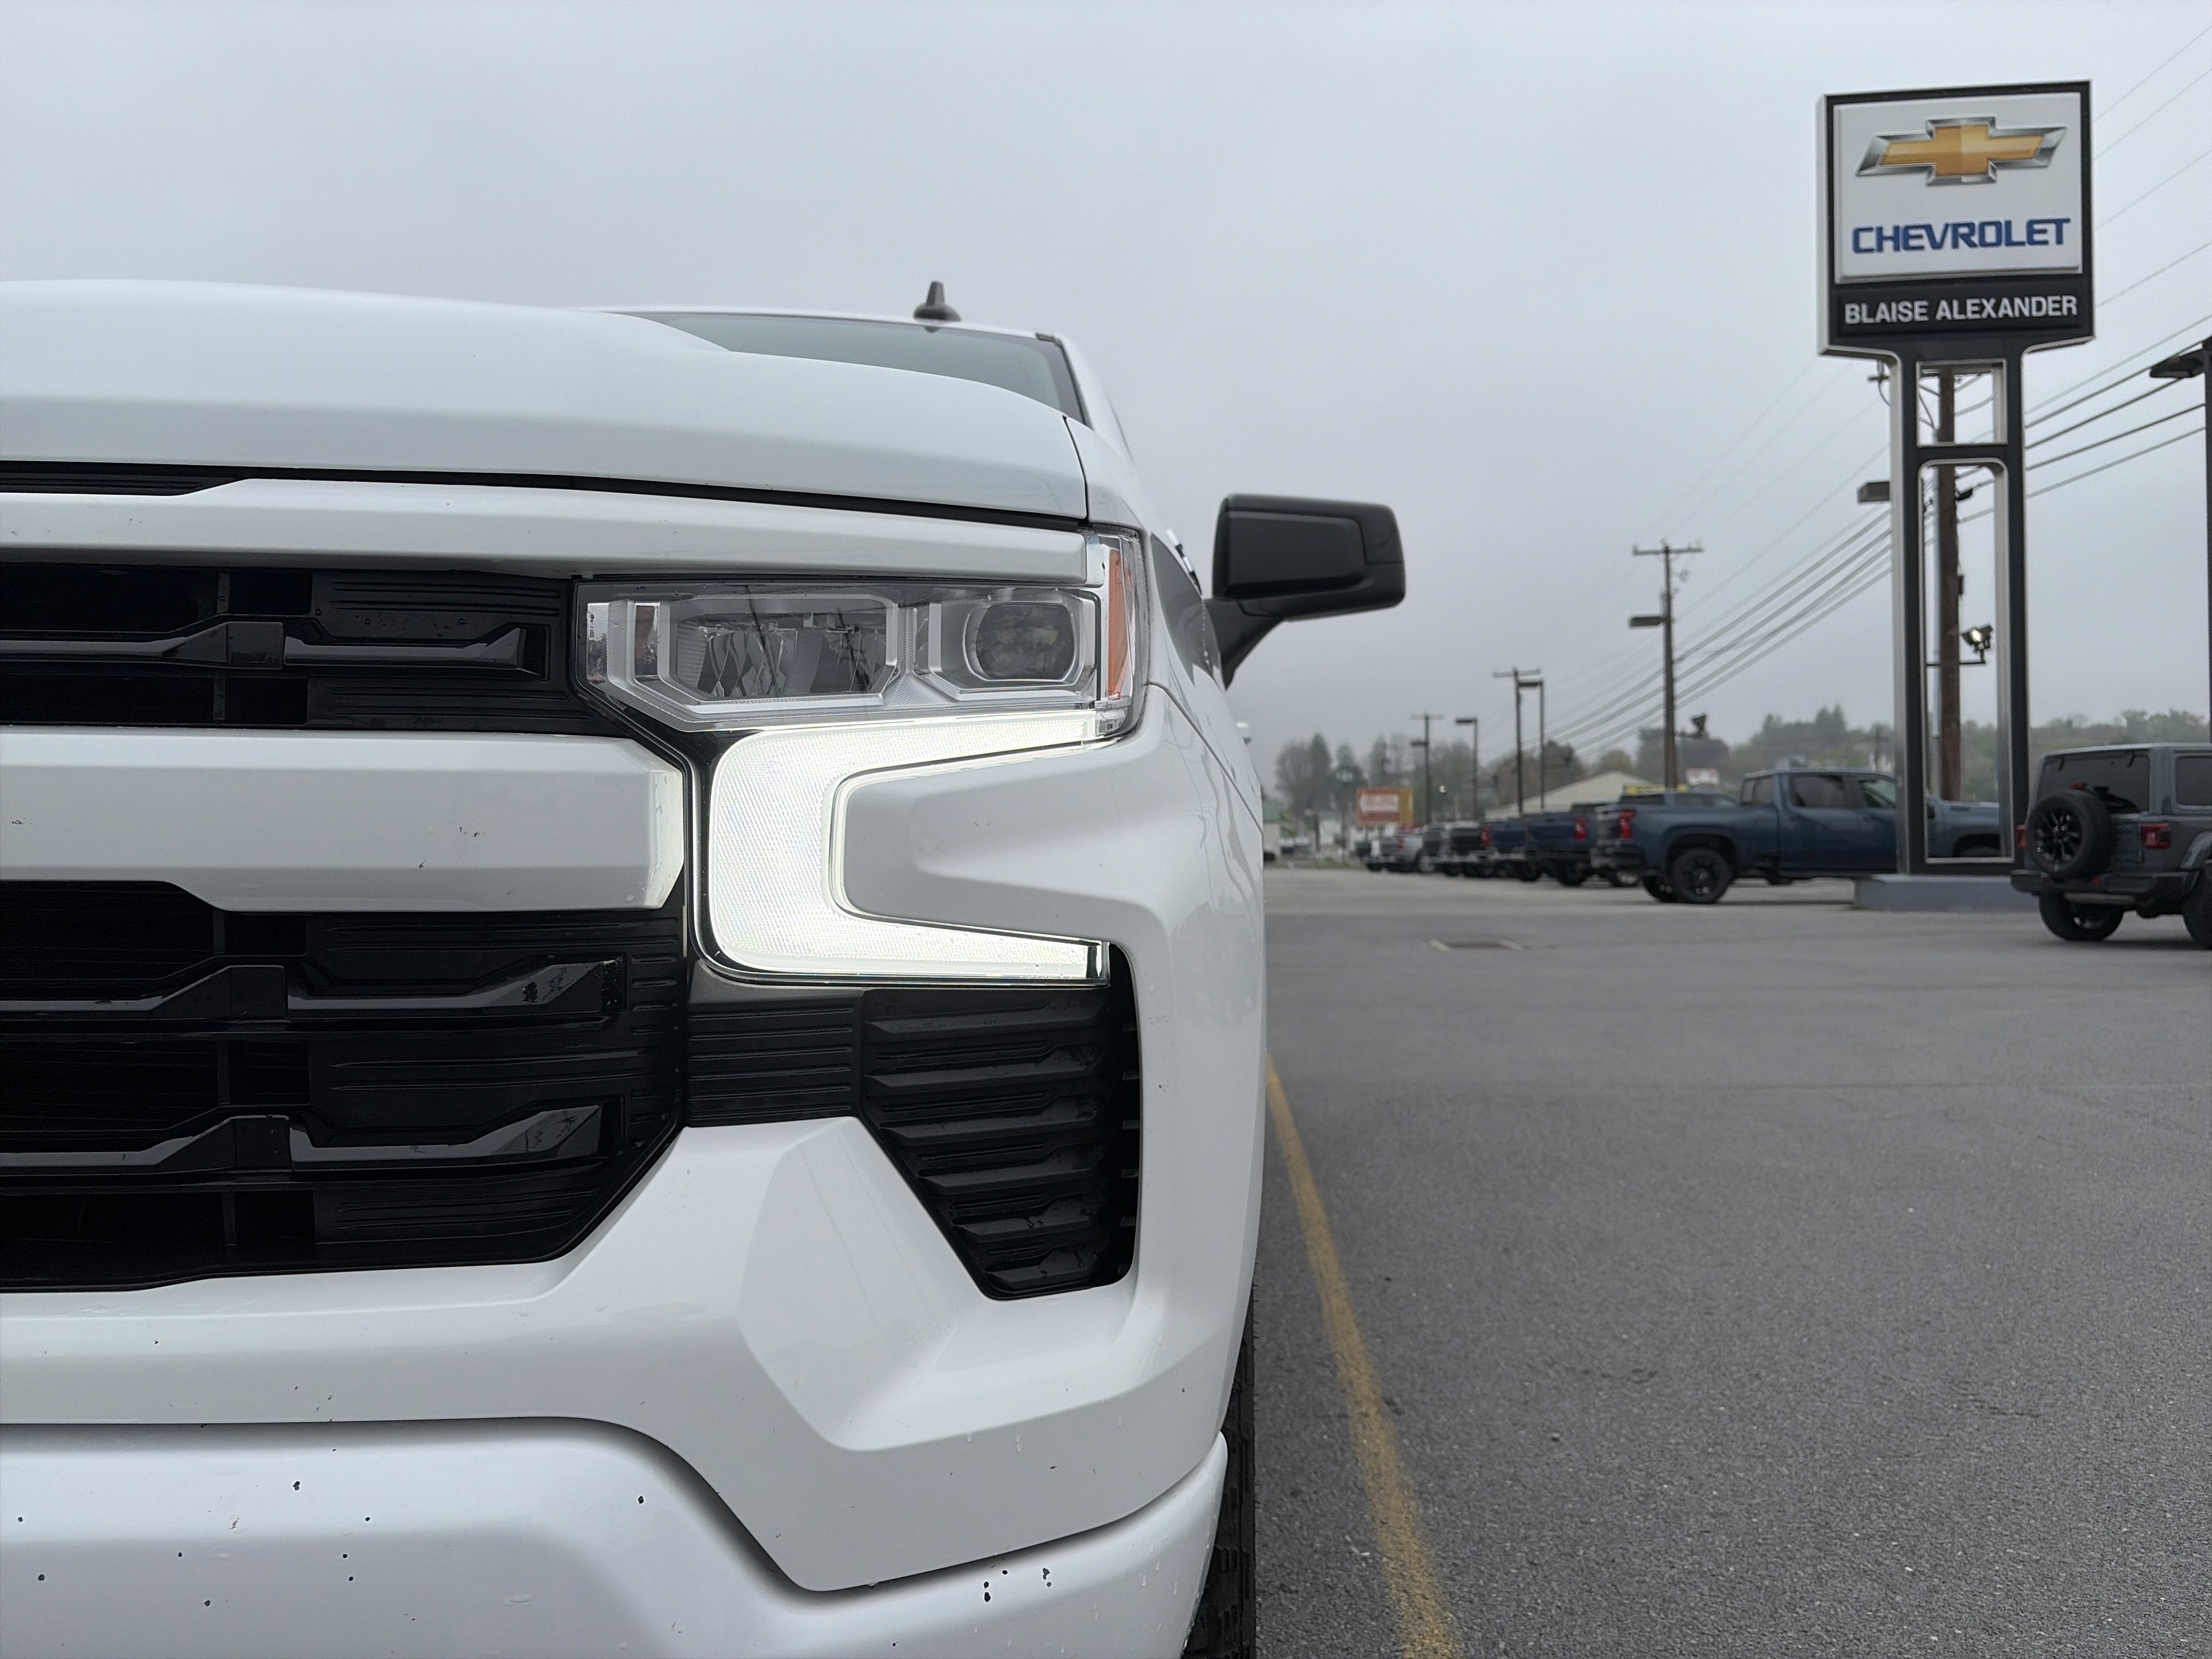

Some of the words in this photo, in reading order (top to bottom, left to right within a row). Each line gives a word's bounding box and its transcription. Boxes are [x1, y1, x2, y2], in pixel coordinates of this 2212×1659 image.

[1852, 218, 2071, 254] CHEVROLET
[1844, 300, 1929, 324] BLAISE
[1936, 295, 2078, 321] ALEXANDER
